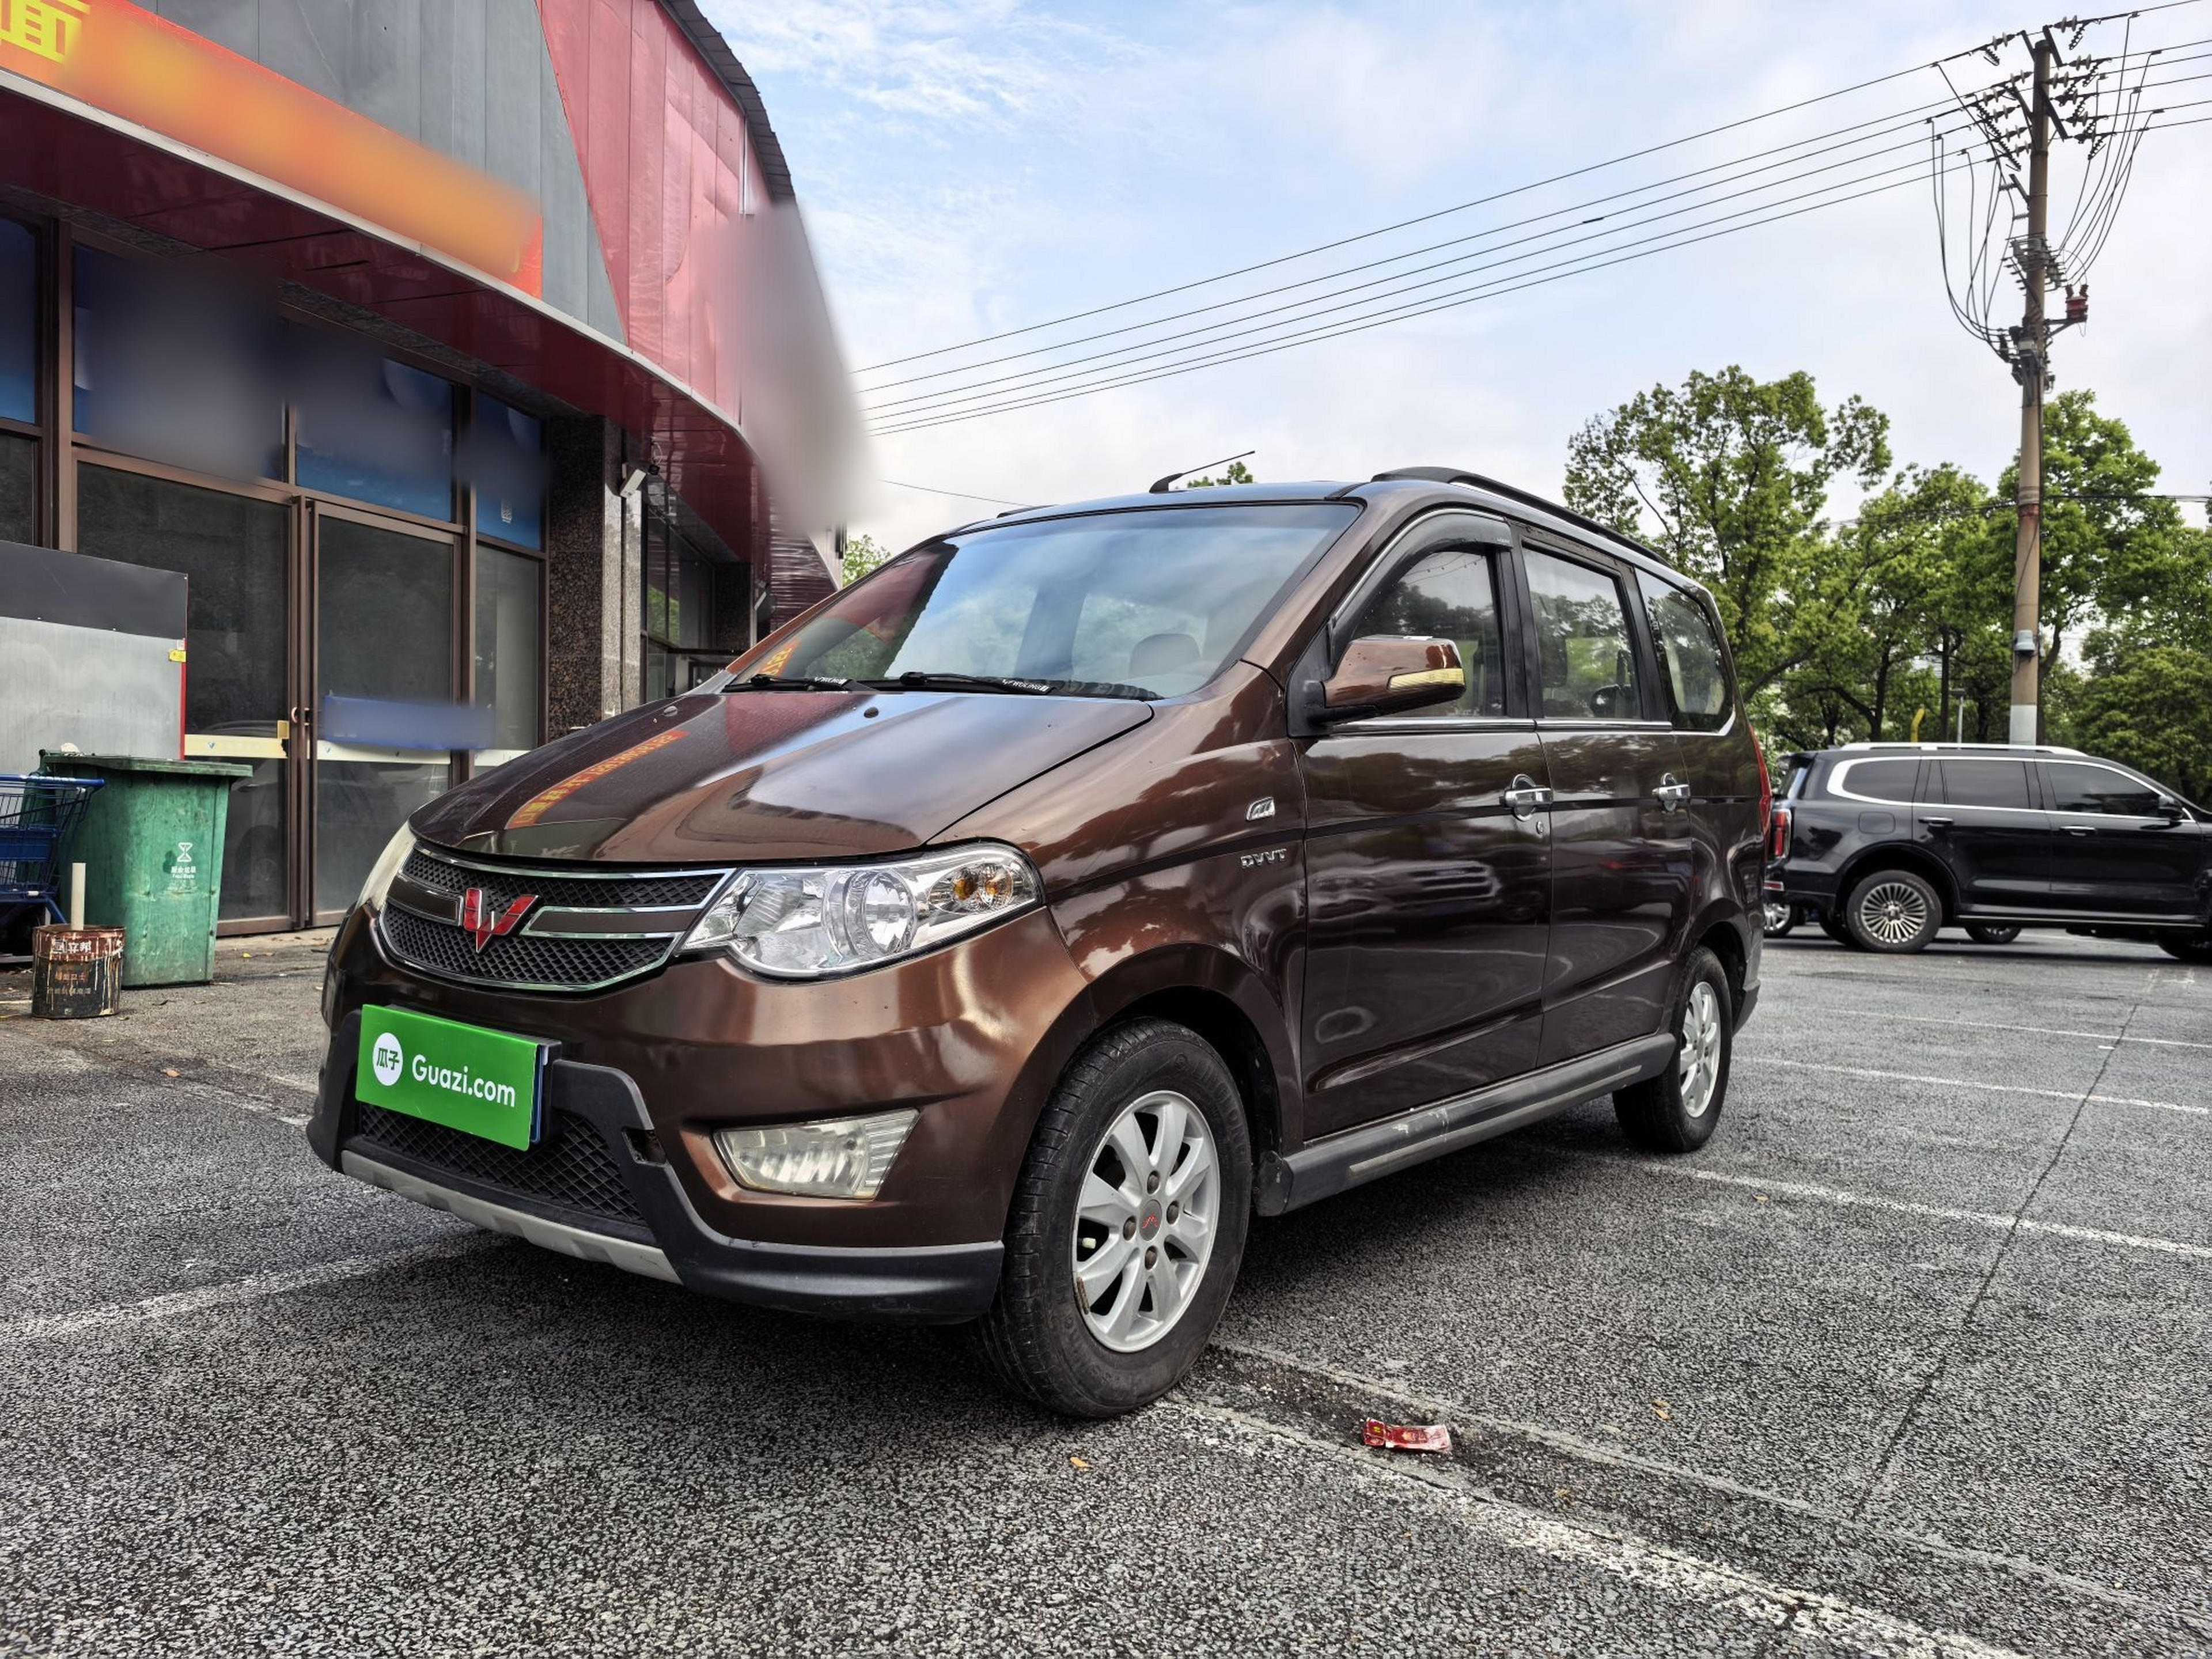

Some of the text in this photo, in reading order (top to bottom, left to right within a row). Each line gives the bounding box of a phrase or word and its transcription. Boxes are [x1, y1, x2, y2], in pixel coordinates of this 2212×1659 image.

[0, 0, 91, 63] 面
[1240, 849, 1287, 868] DVVT
[68, 941, 92, 953] 立邦
[377, 1048, 400, 1070] 瓜子
[412, 1054, 516, 1108] Guazi.com
